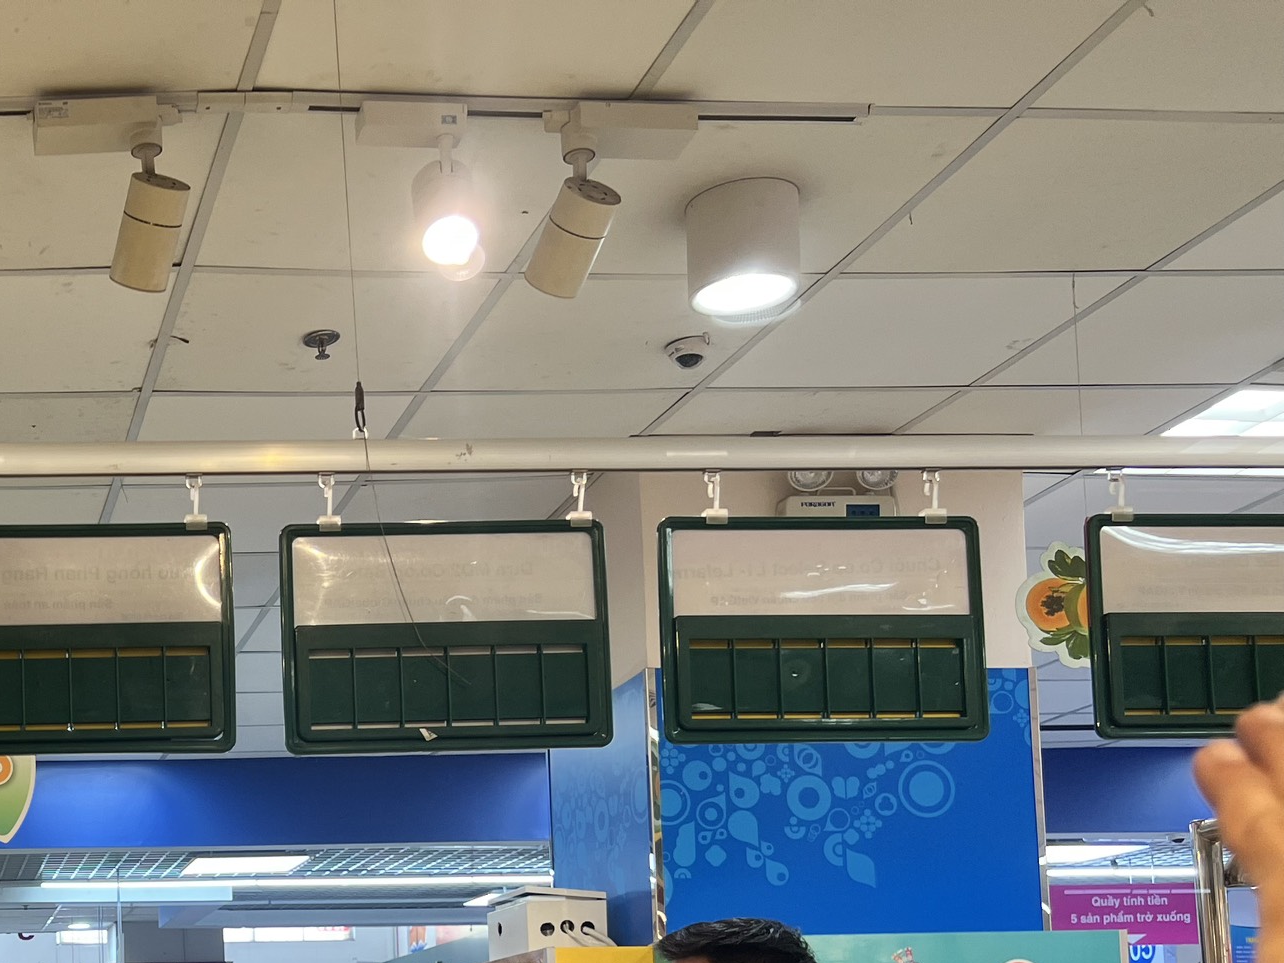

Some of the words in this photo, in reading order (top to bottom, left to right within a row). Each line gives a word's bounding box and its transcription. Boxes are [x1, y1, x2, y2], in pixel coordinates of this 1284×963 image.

[1091, 894, 1120, 909] Quầy
[1123, 895, 1145, 906] tính
[1147, 893, 1168, 906] tiền
[1070, 913, 1077, 924] 5
[1080, 911, 1100, 924] sản
[1103, 909, 1134, 926] phẩm
[1156, 909, 1191, 924] xuống
